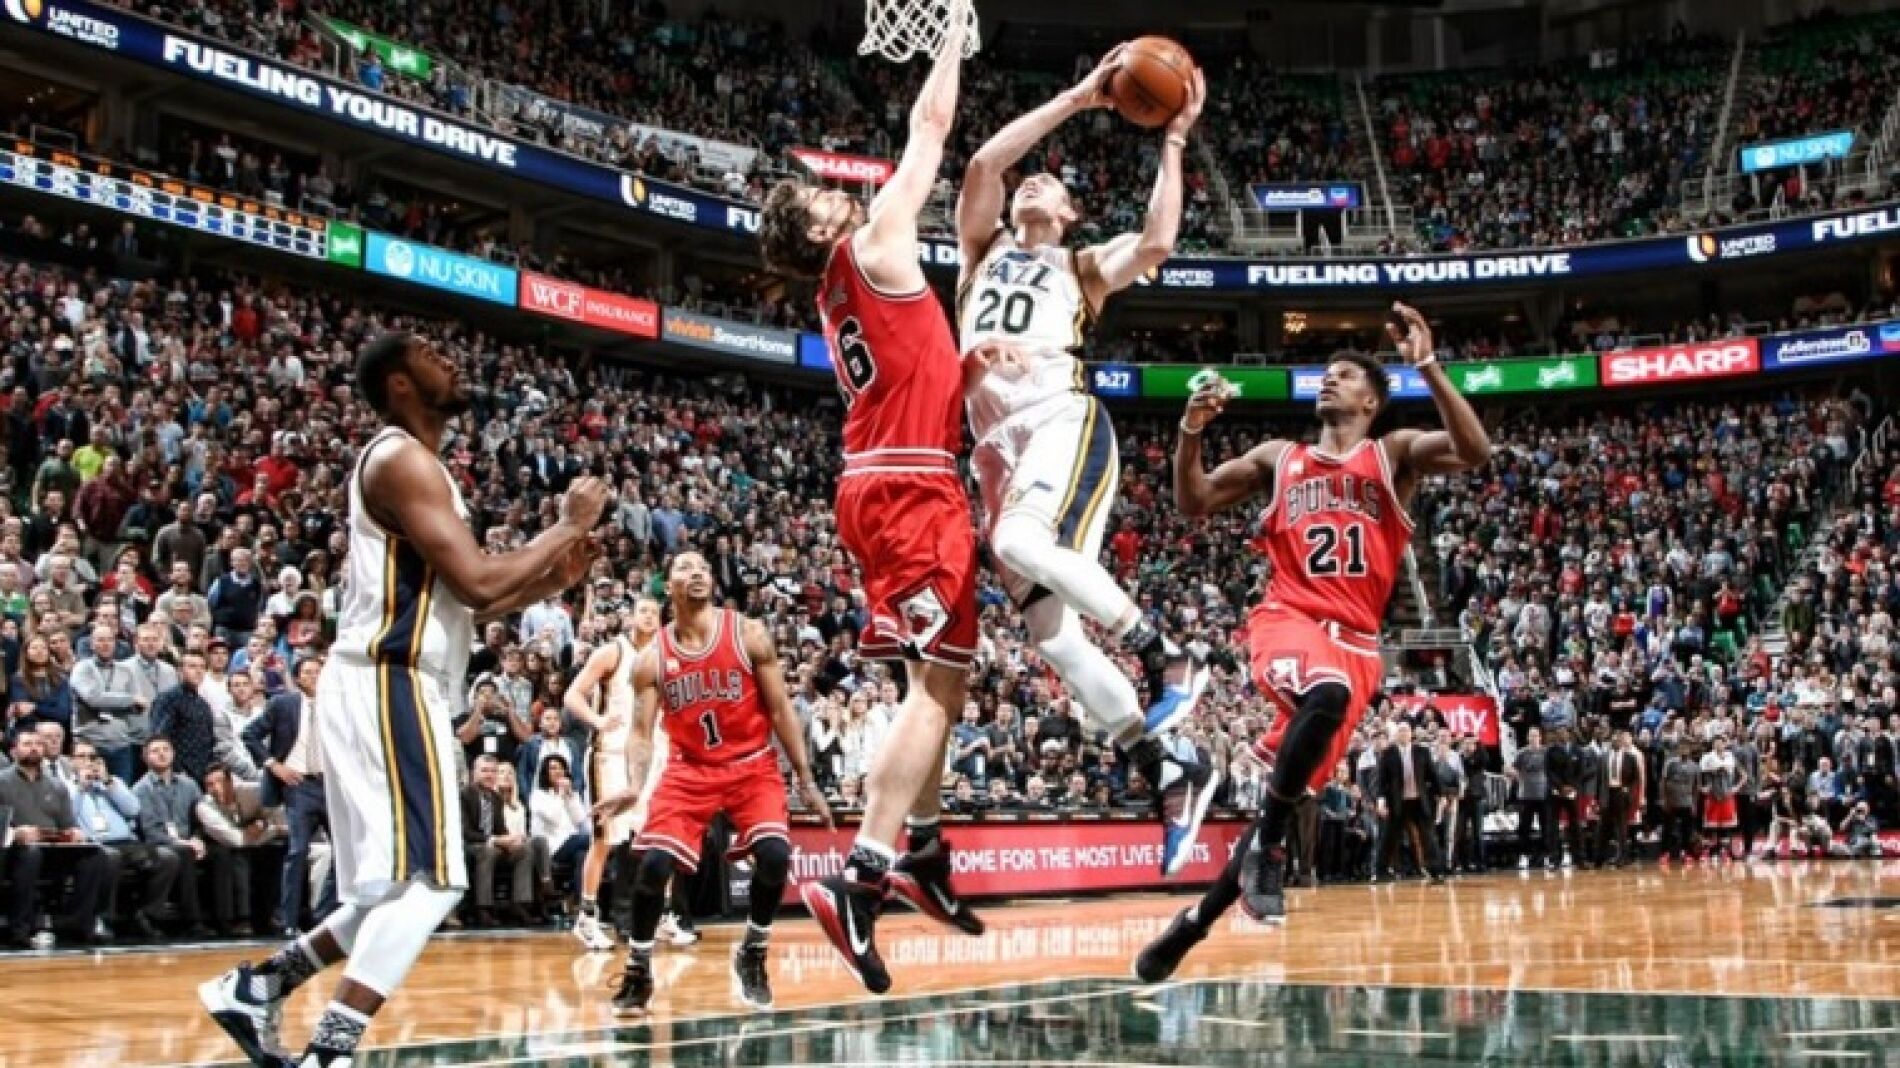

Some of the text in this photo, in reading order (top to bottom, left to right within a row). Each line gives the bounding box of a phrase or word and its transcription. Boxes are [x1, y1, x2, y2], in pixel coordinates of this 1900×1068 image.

[163, 34, 321, 106] FUELING
[326, 86, 418, 136] YOUR
[423, 117, 517, 167] DRIVE
[418, 253, 500, 294] NU SKIN
[1248, 252, 1571, 285] FUELING YOUR DRIVE
[530, 281, 655, 328] WCF INSURANCE
[975, 288, 1035, 334] 20
[1609, 345, 1750, 381] SHARP
[1284, 474, 1382, 526] BULLS
[1304, 522, 1368, 578] 21
[664, 668, 743, 714] BULLS
[699, 708, 723, 749] 1
[1000, 848, 1036, 872] FOR
[1038, 846, 1071, 870] THE
[1074, 845, 1119, 869] MOST
[1122, 844, 1154, 866] LIVE
